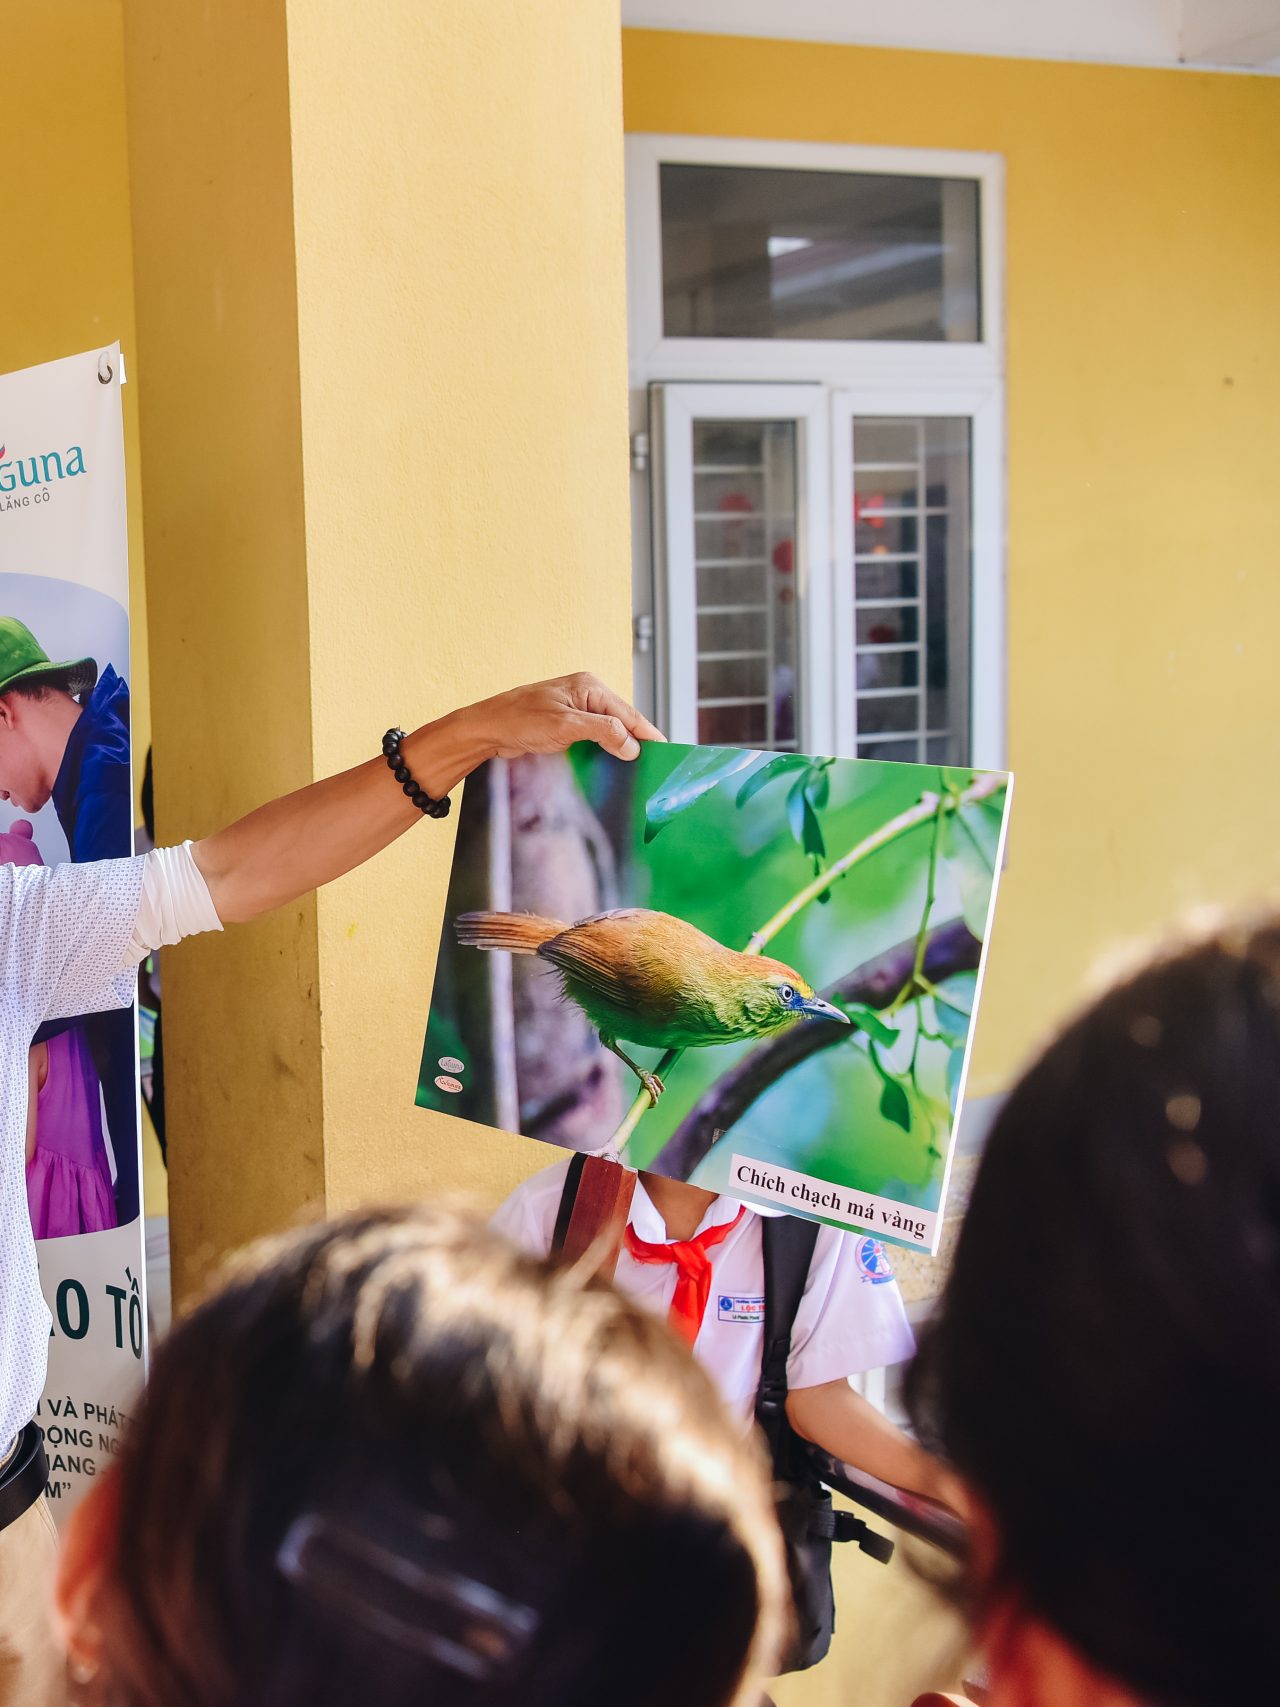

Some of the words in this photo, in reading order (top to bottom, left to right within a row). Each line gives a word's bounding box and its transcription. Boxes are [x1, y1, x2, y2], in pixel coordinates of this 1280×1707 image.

[0, 495, 30, 512] LĂNG
[34, 487, 51, 504] CÔ
[737, 1165, 785, 1194] Chích
[791, 1184, 841, 1210] chạch
[847, 1203, 874, 1221] má
[881, 1209, 927, 1241] vàng
[47, 1396, 78, 1418] VÀ
[84, 1402, 127, 1432] PHÁT
